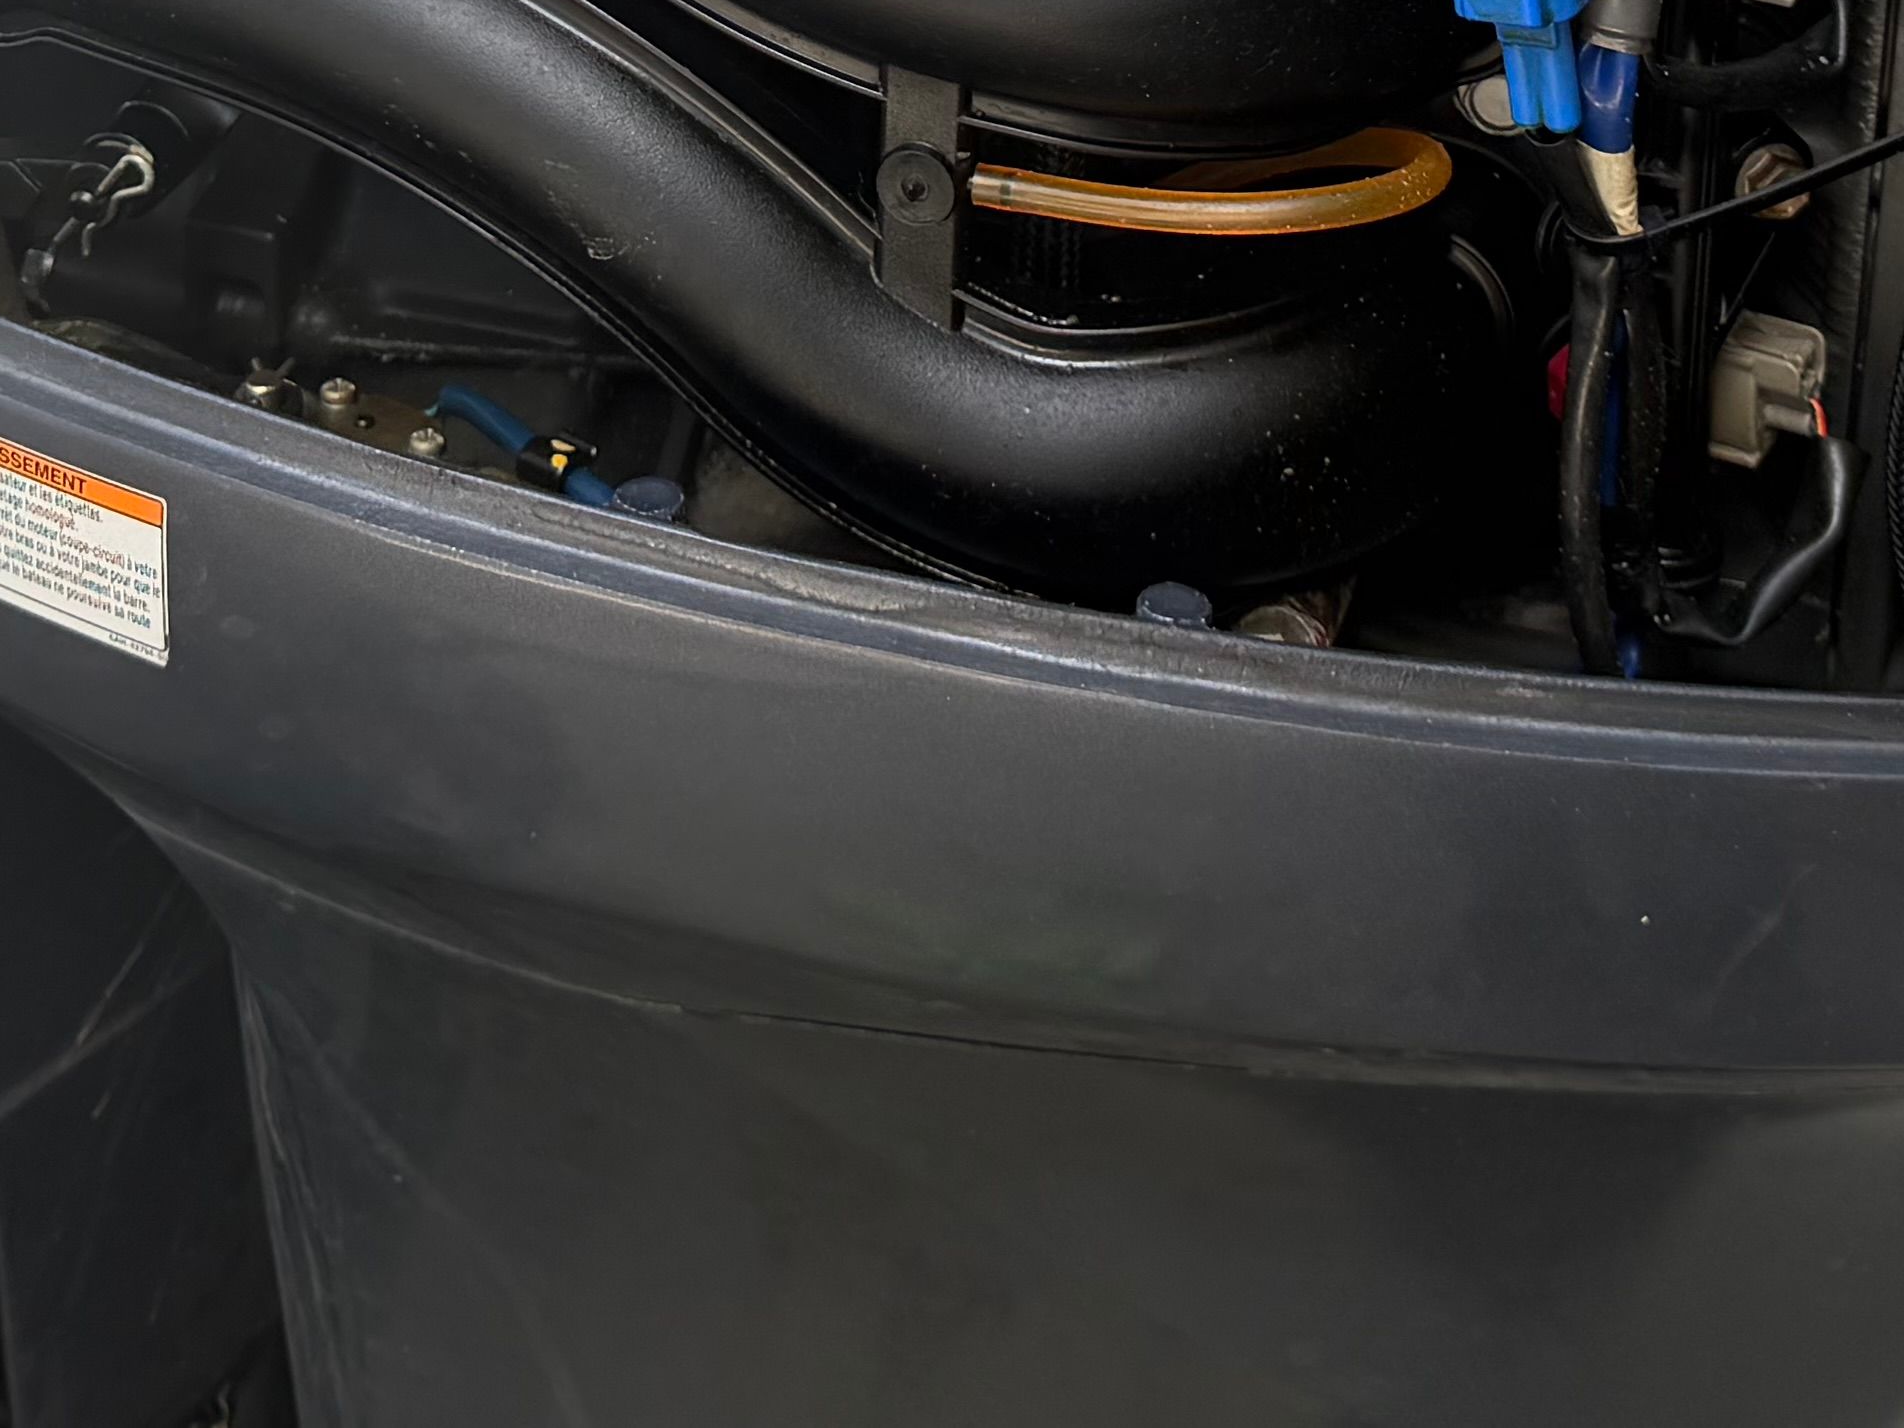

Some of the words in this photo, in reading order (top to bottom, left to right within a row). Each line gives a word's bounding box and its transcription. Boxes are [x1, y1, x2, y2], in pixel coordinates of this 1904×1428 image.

[28, 484, 37, 497] et
[39, 485, 52, 504] les
[4, 544, 34, 567] quittez
[36, 558, 111, 598] accidentellement
[113, 585, 121, 602] la
[123, 589, 150, 613] barre.
[14, 513, 26, 528] du
[28, 519, 58, 541] moteur
[59, 528, 125, 570] (coupe-circuit)
[127, 554, 132, 571] à
[134, 561, 158, 580] votre
[15, 529, 34, 549] bras
[36, 541, 47, 555] ou
[49, 542, 55, 558] à
[57, 549, 80, 568] votre
[81, 555, 108, 580] jambe
[110, 570, 131, 590] pour
[134, 579, 150, 595] que
[152, 582, 160, 599] le
[12, 562, 20, 576] le
[22, 566, 52, 590] bateau
[54, 581, 64, 595] ne
[66, 586, 112, 614] poursuive
[114, 605, 124, 619] sa
[127, 610, 150, 629] route
